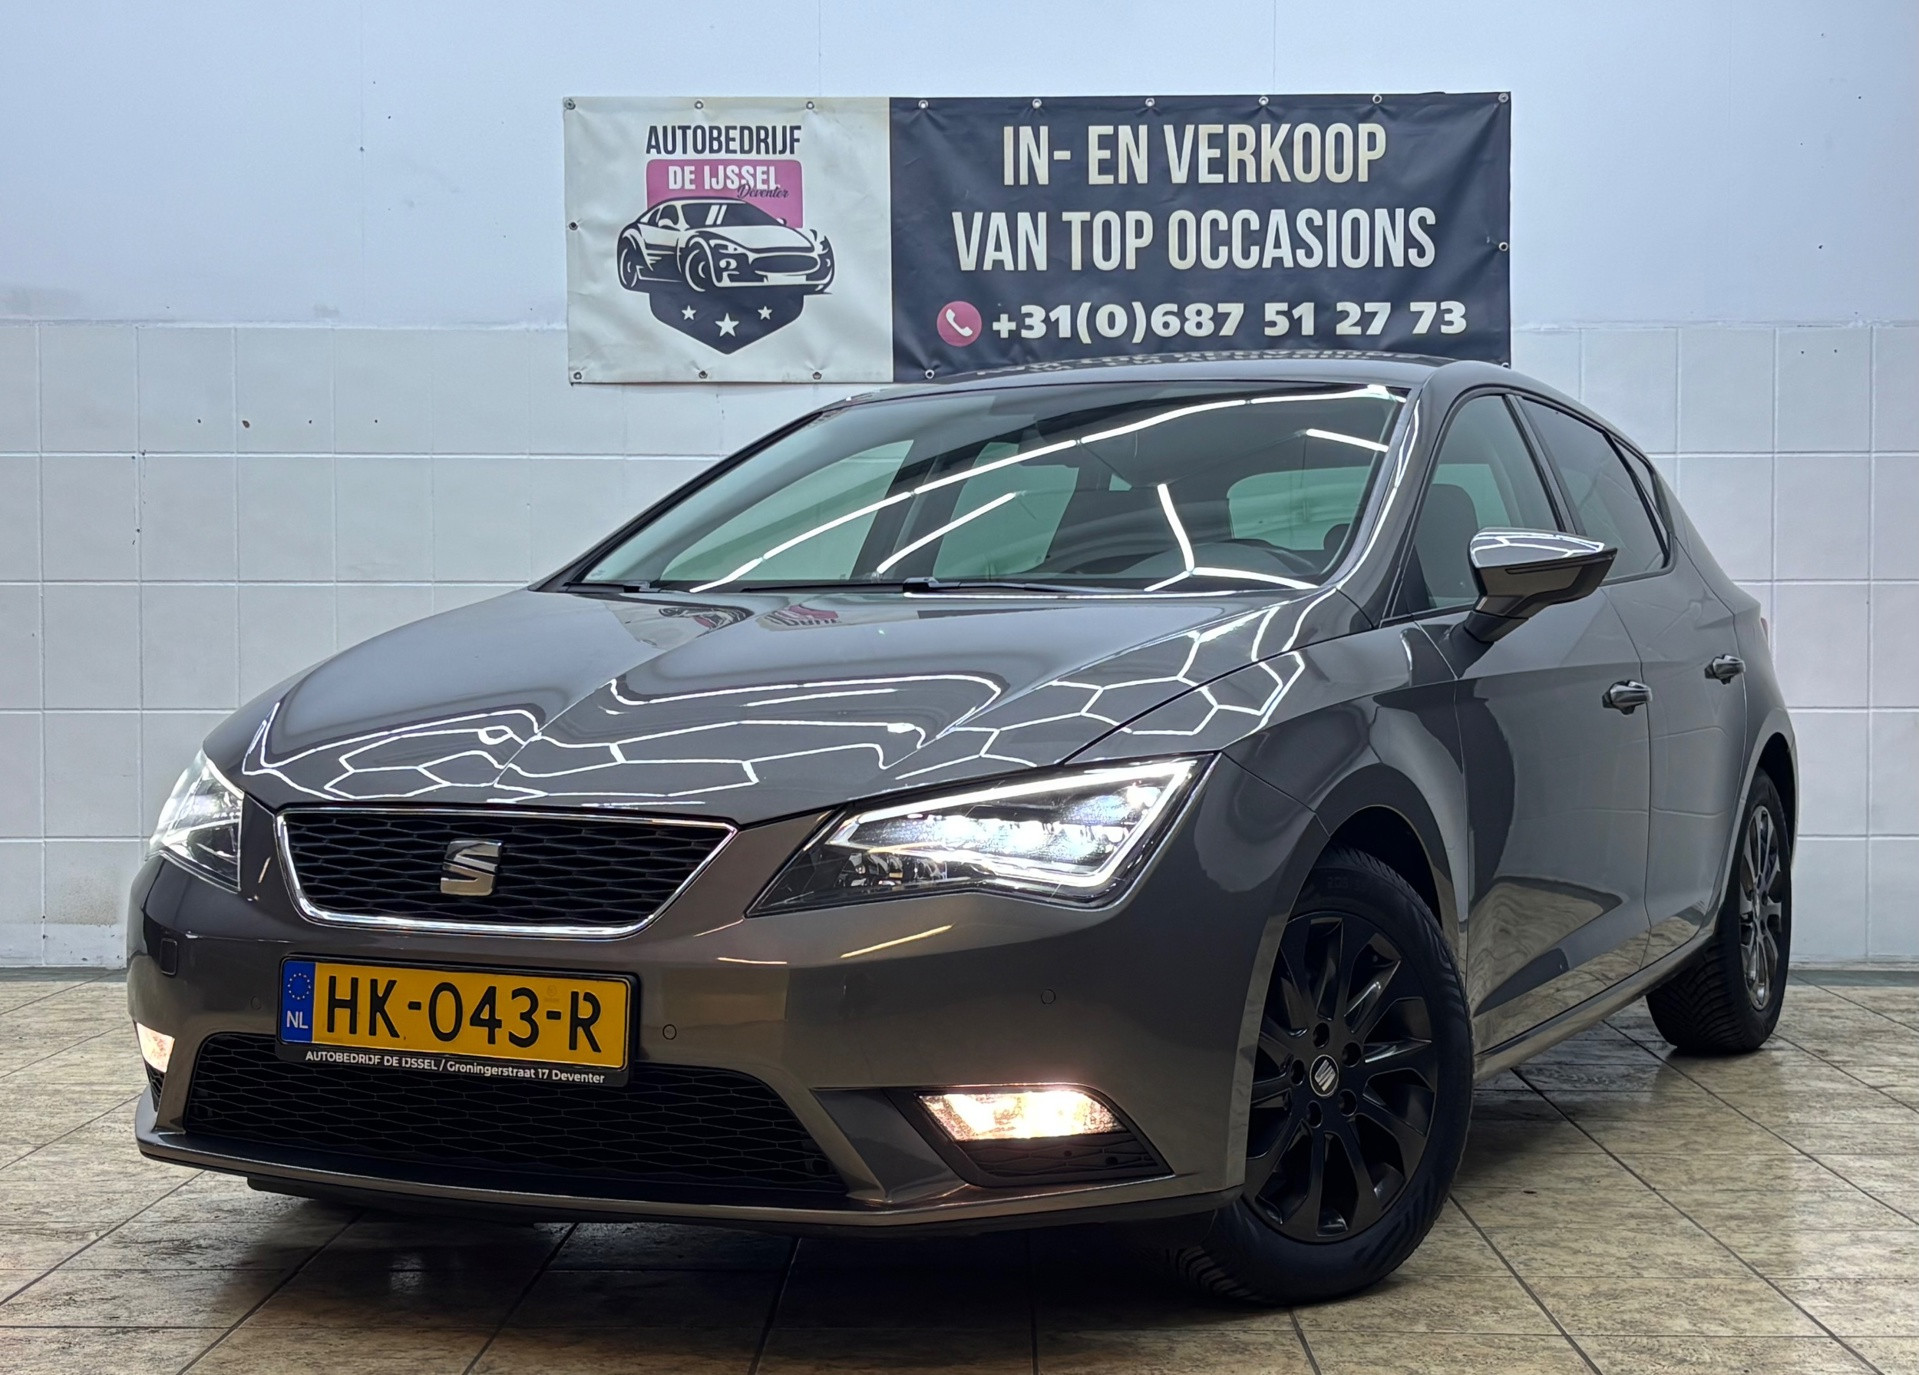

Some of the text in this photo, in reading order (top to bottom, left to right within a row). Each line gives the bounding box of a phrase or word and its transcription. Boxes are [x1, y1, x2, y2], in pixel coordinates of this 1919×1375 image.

[646, 125, 802, 155] AUTOBEDRIJF
[1003, 122, 1387, 185] IN- EN VERKOOP
[668, 165, 781, 190] DE IJSSEL
[736, 182, 790, 200] Deventer
[952, 207, 1437, 271] VAN TOP OCCASIONS
[991, 301, 1468, 345] +31(0)687 51 27 73
[286, 1010, 309, 1030] NL
[326, 975, 602, 1053] HK-043-R
[305, 1050, 382, 1066] AUTOBEDRIJF
[383, 1055, 400, 1067] DE
[401, 1057, 438, 1071] IJSSEL
[446, 1061, 536, 1079] Groningerstraat
[537, 1068, 550, 1080] 17
[551, 1069, 606, 1084] Deventer
